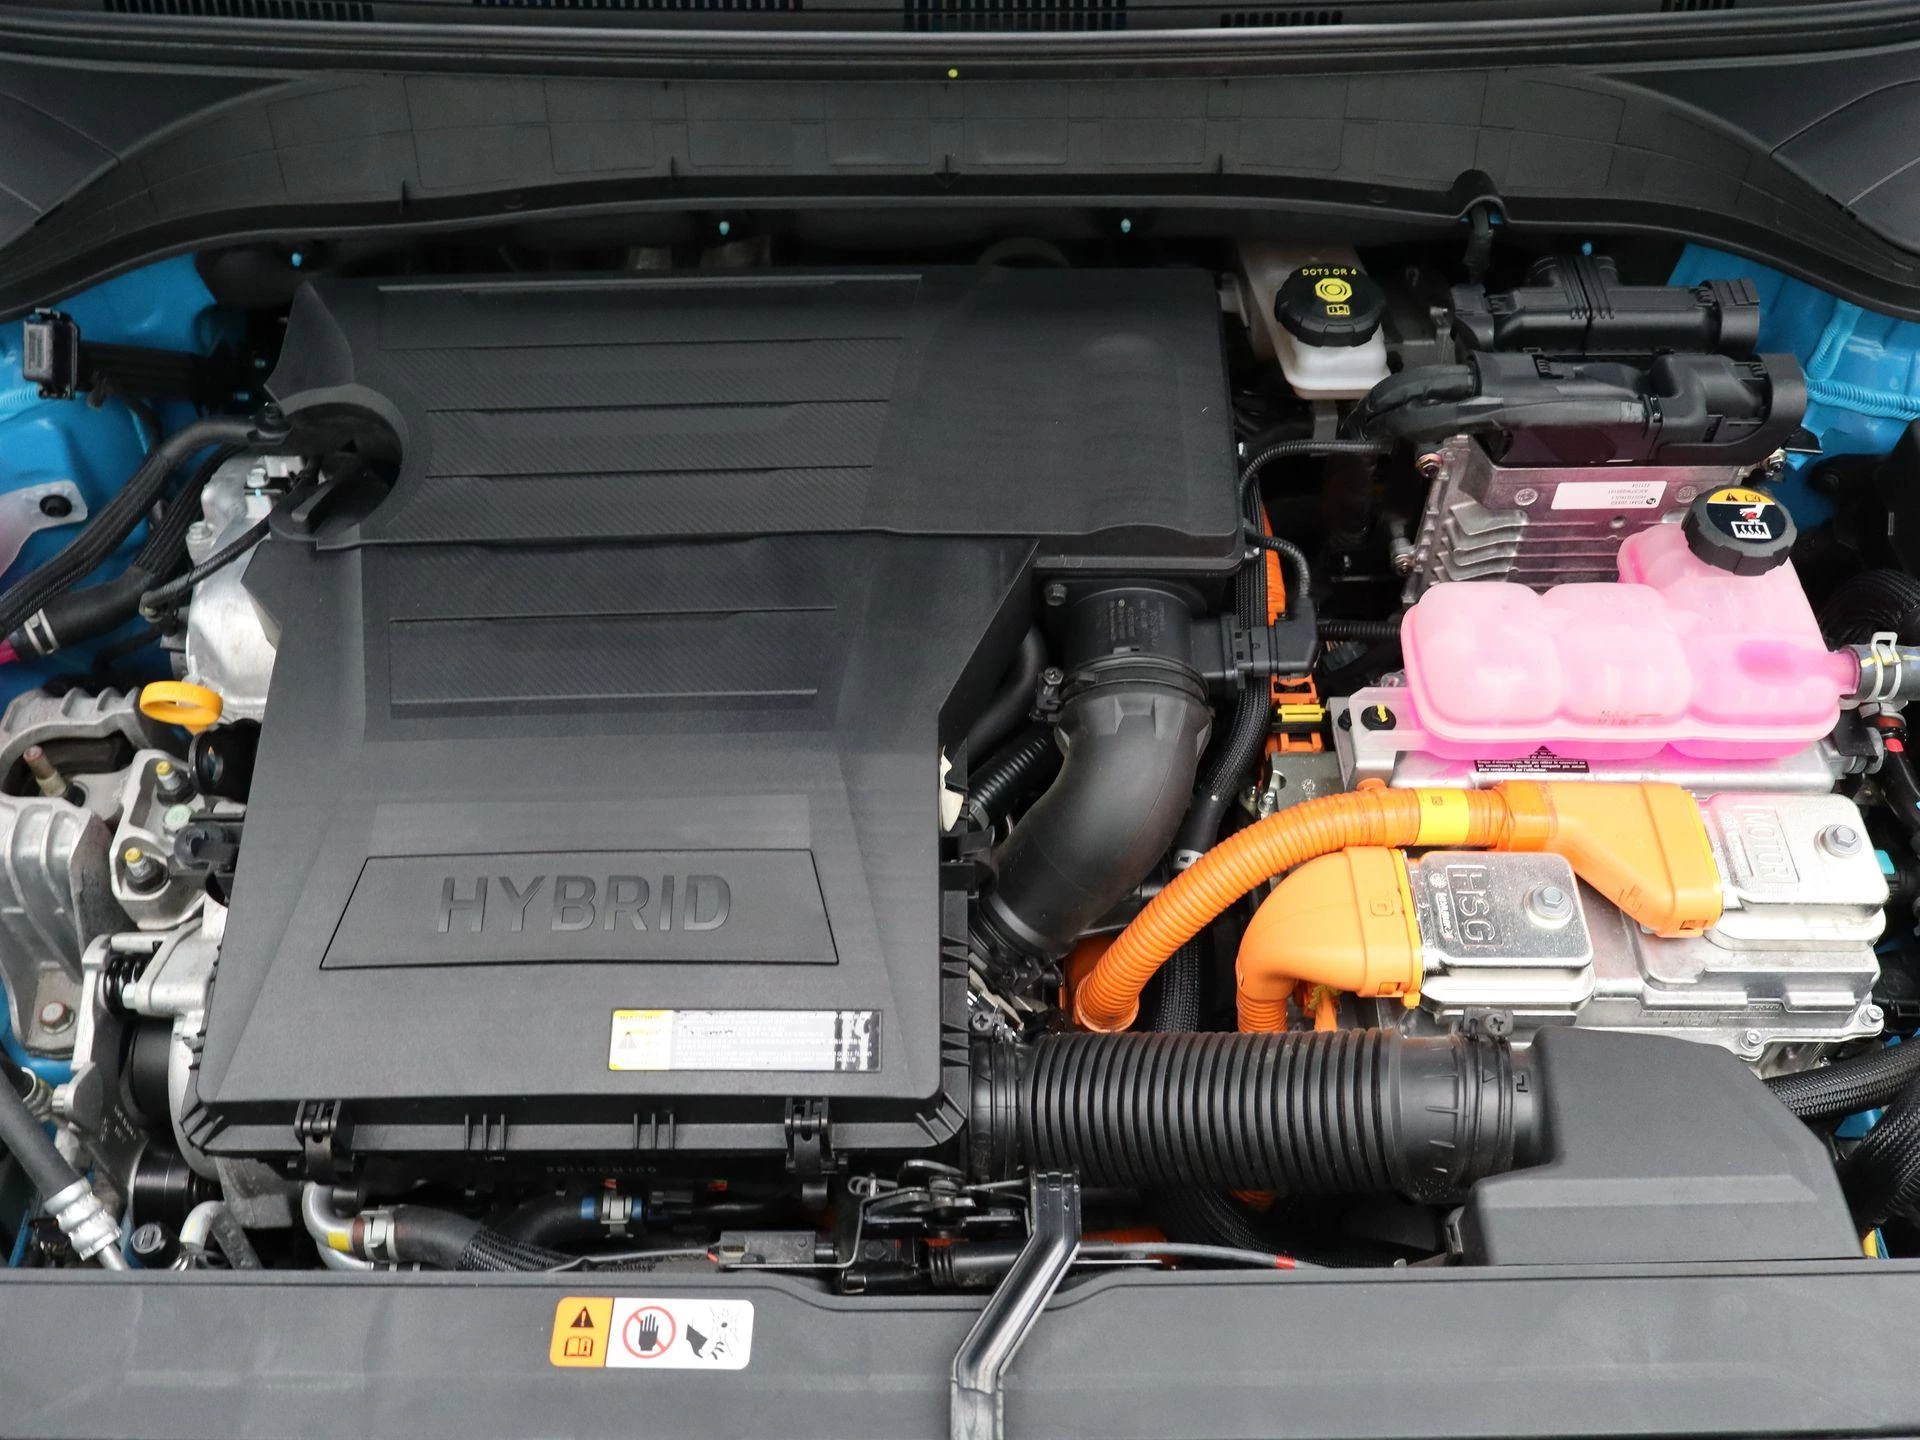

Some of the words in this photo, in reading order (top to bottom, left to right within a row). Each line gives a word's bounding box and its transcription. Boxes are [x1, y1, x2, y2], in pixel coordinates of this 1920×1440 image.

[1302, 268, 1329, 276] DOT3
[1743, 812, 1790, 878] MOTOR
[437, 875, 731, 932] HYBRID
[1452, 873, 1496, 942] HSG
